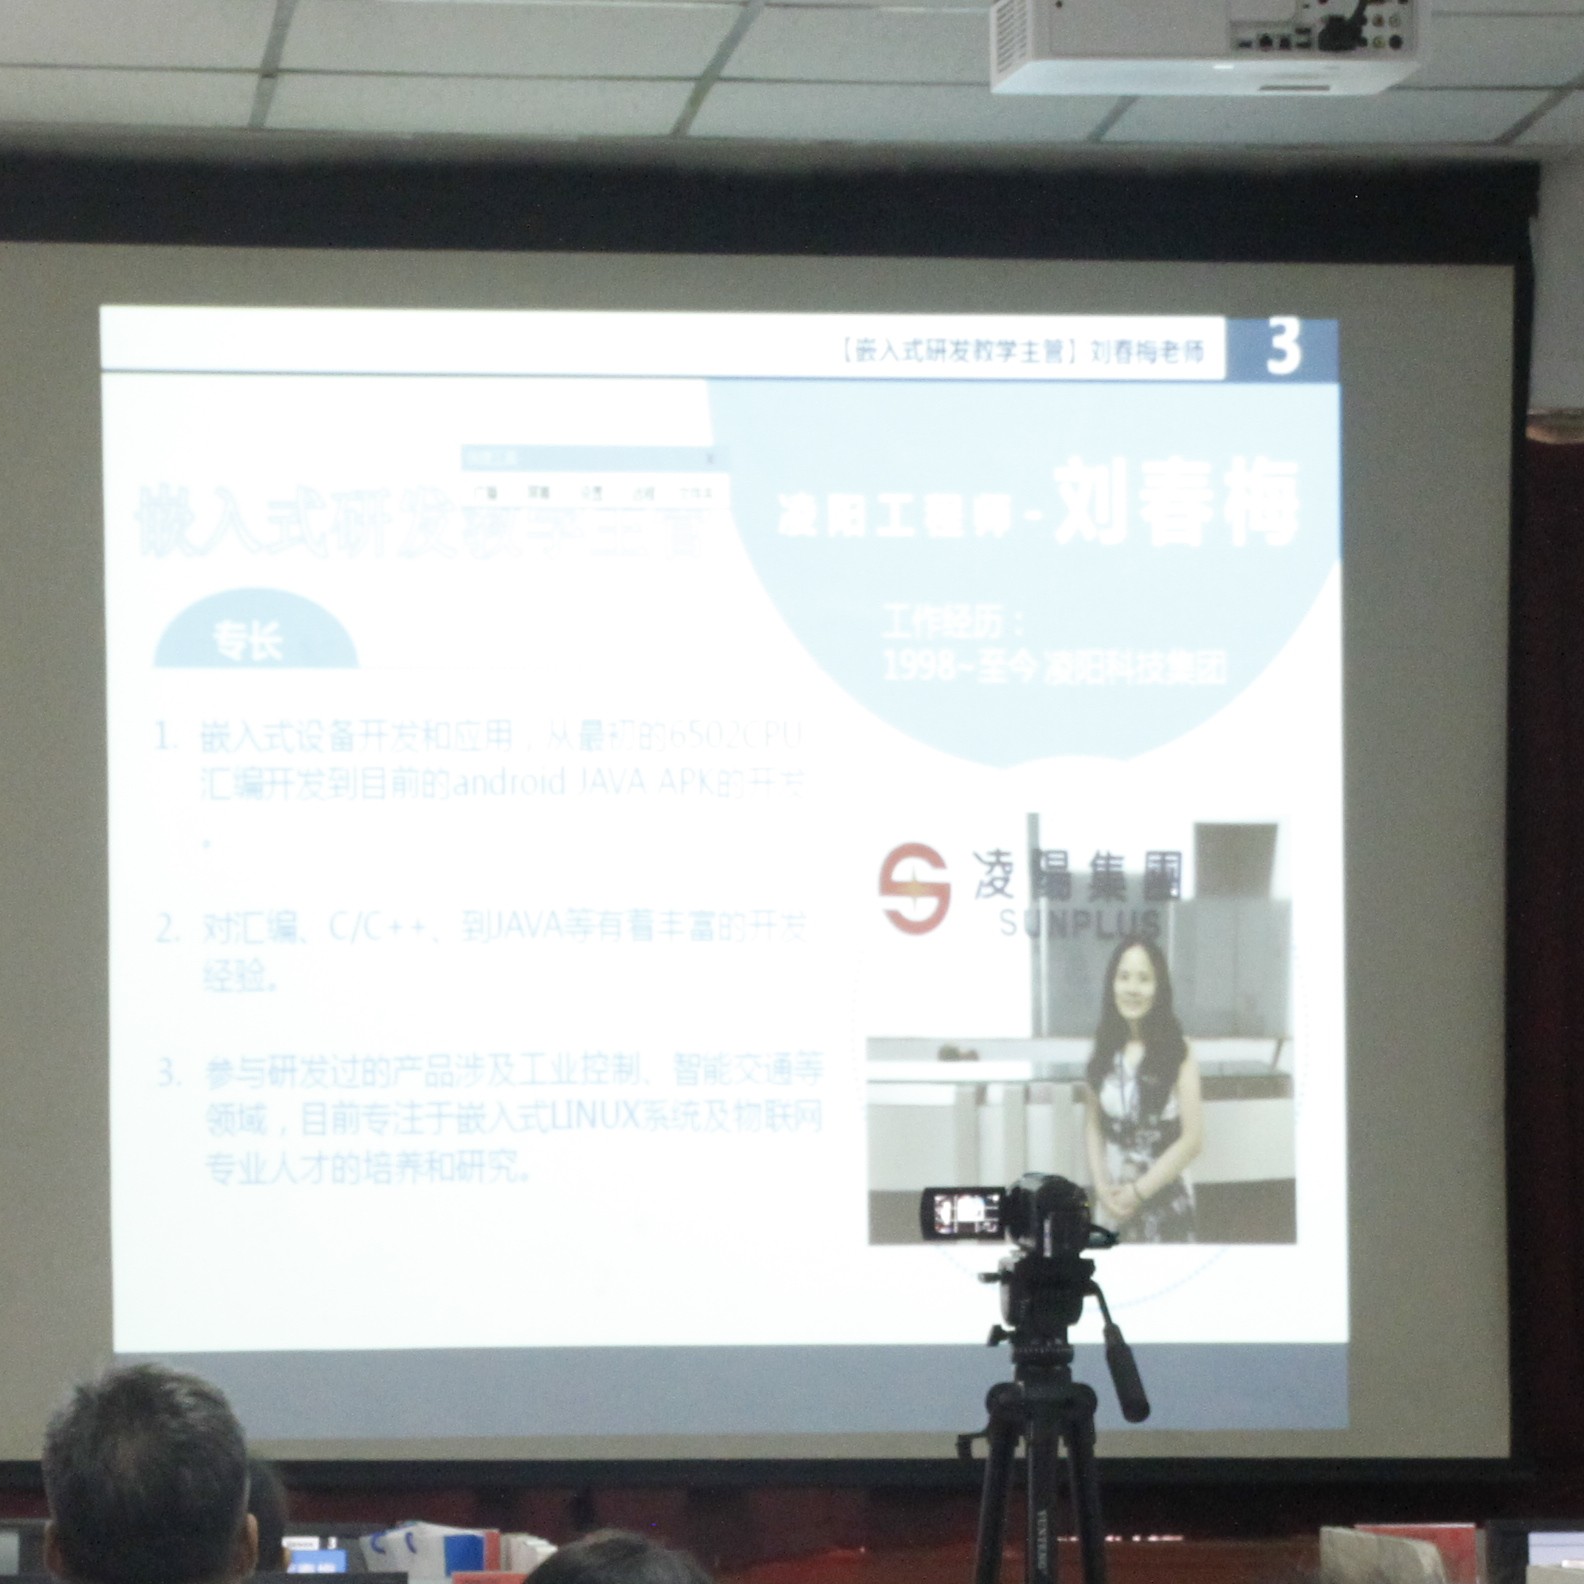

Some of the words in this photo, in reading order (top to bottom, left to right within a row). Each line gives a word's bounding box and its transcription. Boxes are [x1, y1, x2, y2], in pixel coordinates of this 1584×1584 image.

[1266, 316, 1302, 375] 3
[213, 619, 283, 662] 专长
[1043, 648, 1227, 687] 凌阳科技集团
[577, 767, 646, 801] JAVA
[999, 908, 1162, 940] SUNPLUS
